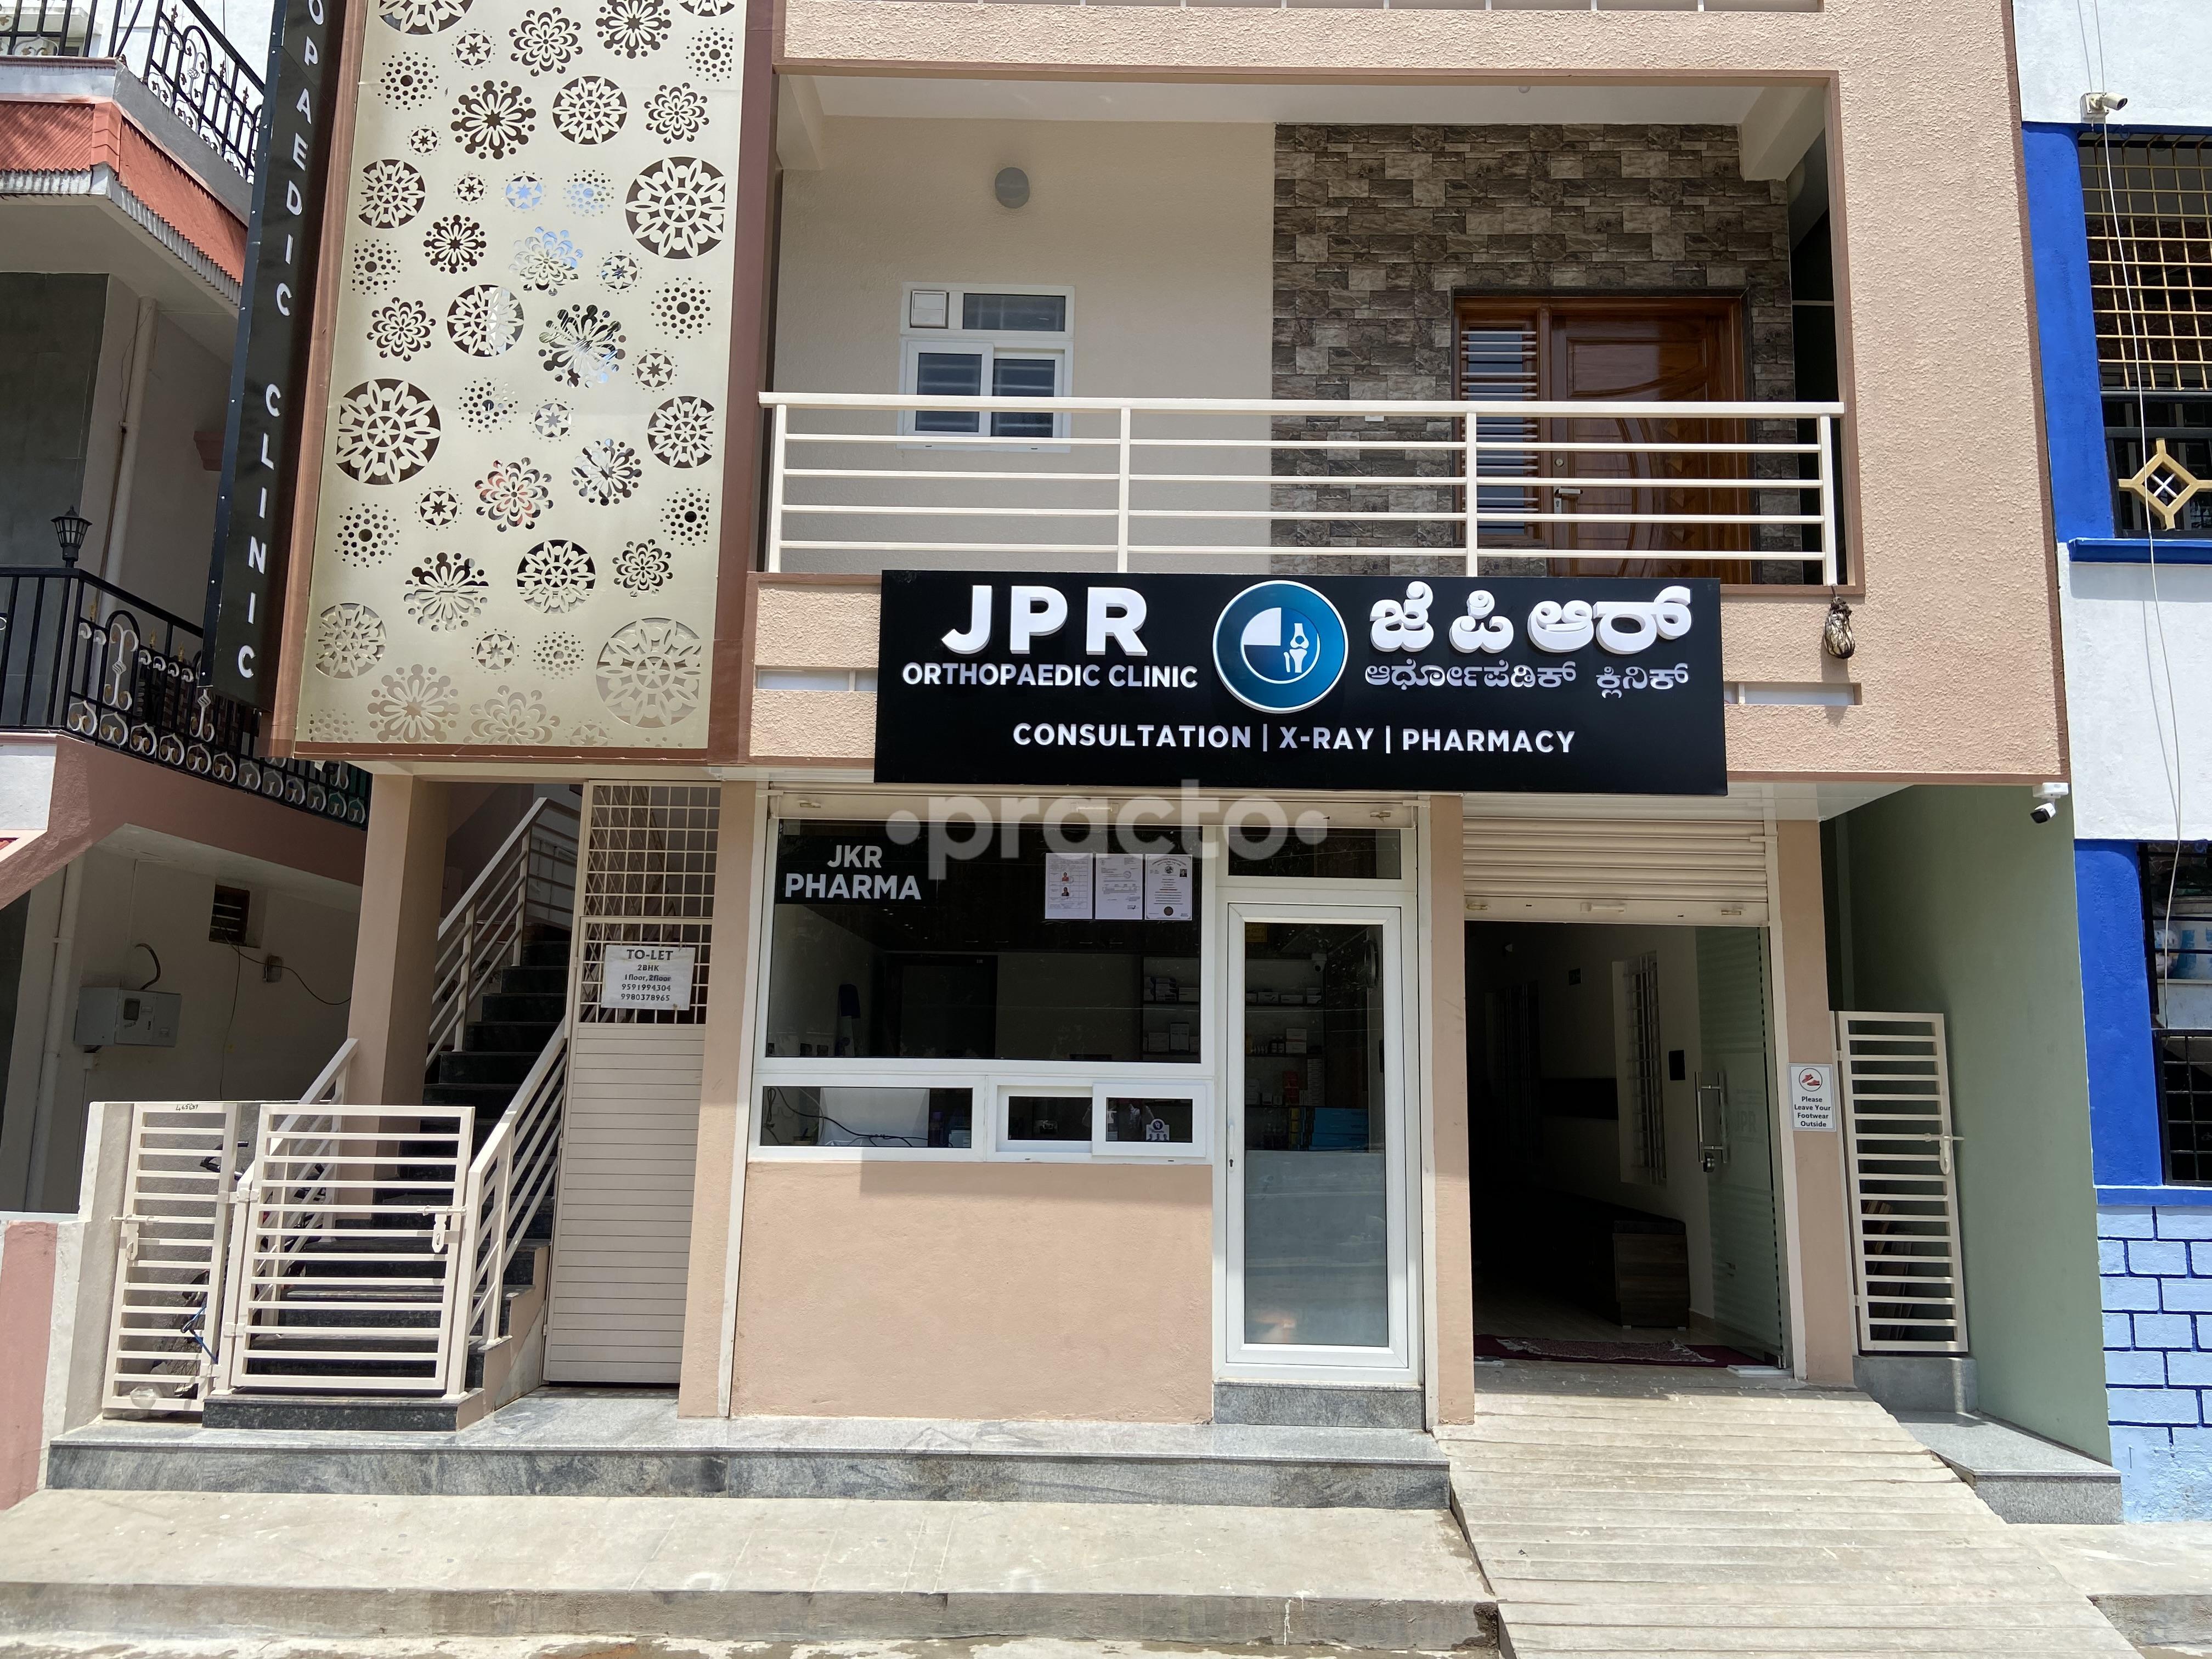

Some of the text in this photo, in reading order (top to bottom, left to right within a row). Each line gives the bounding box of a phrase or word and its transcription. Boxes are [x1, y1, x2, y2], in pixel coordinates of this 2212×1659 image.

[239, 383, 280, 679] CLINIC
[941, 585, 1148, 656] JPR
[1370, 581, 1691, 654] ಜೆ ಪಿ ಆರ್
[902, 662, 1198, 688] ORTHOPAEDIC CLINIC
[1013, 723, 1251, 748] CONSULTATION
[1279, 726, 1374, 750] X-RAY
[1403, 729, 1576, 753] PHARMACY
[827, 845, 882, 868] JKR
[785, 873, 922, 900] PHARMA
[627, 949, 674, 961] TO-LET
